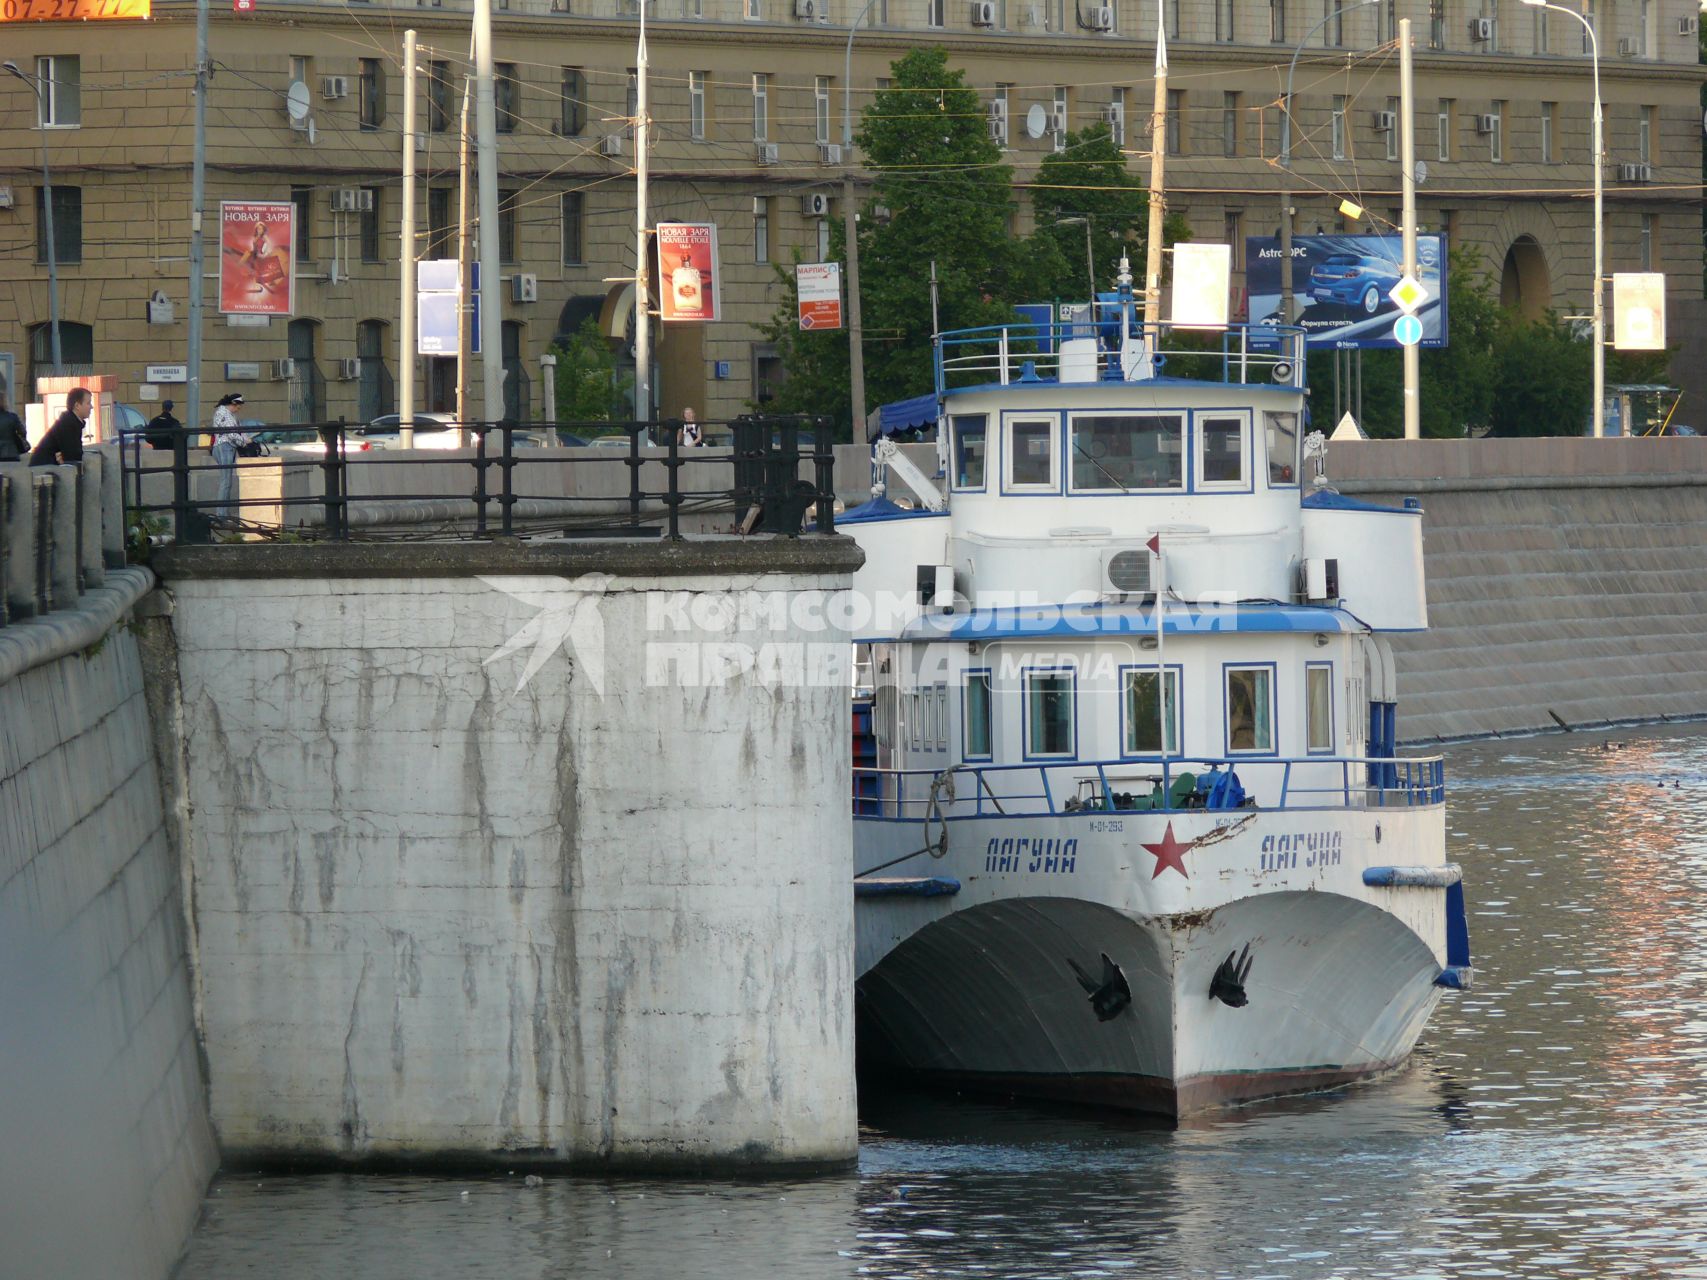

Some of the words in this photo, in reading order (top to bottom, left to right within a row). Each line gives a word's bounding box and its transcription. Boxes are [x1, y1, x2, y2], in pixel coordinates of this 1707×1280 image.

[225, 212, 260, 222] НОВАЯ
[265, 212, 290, 222] ЗАРЯ
[660, 227, 687, 236] НОВАЯ
[690, 227, 709, 236] ЗАРЯ
[661, 236, 689, 244] NOUVELLE
[797, 265, 828, 275] МАРПИС
[1260, 830, 1342, 870] ЛАГУНА
[985, 838, 1078, 873] ЛАГУНА
